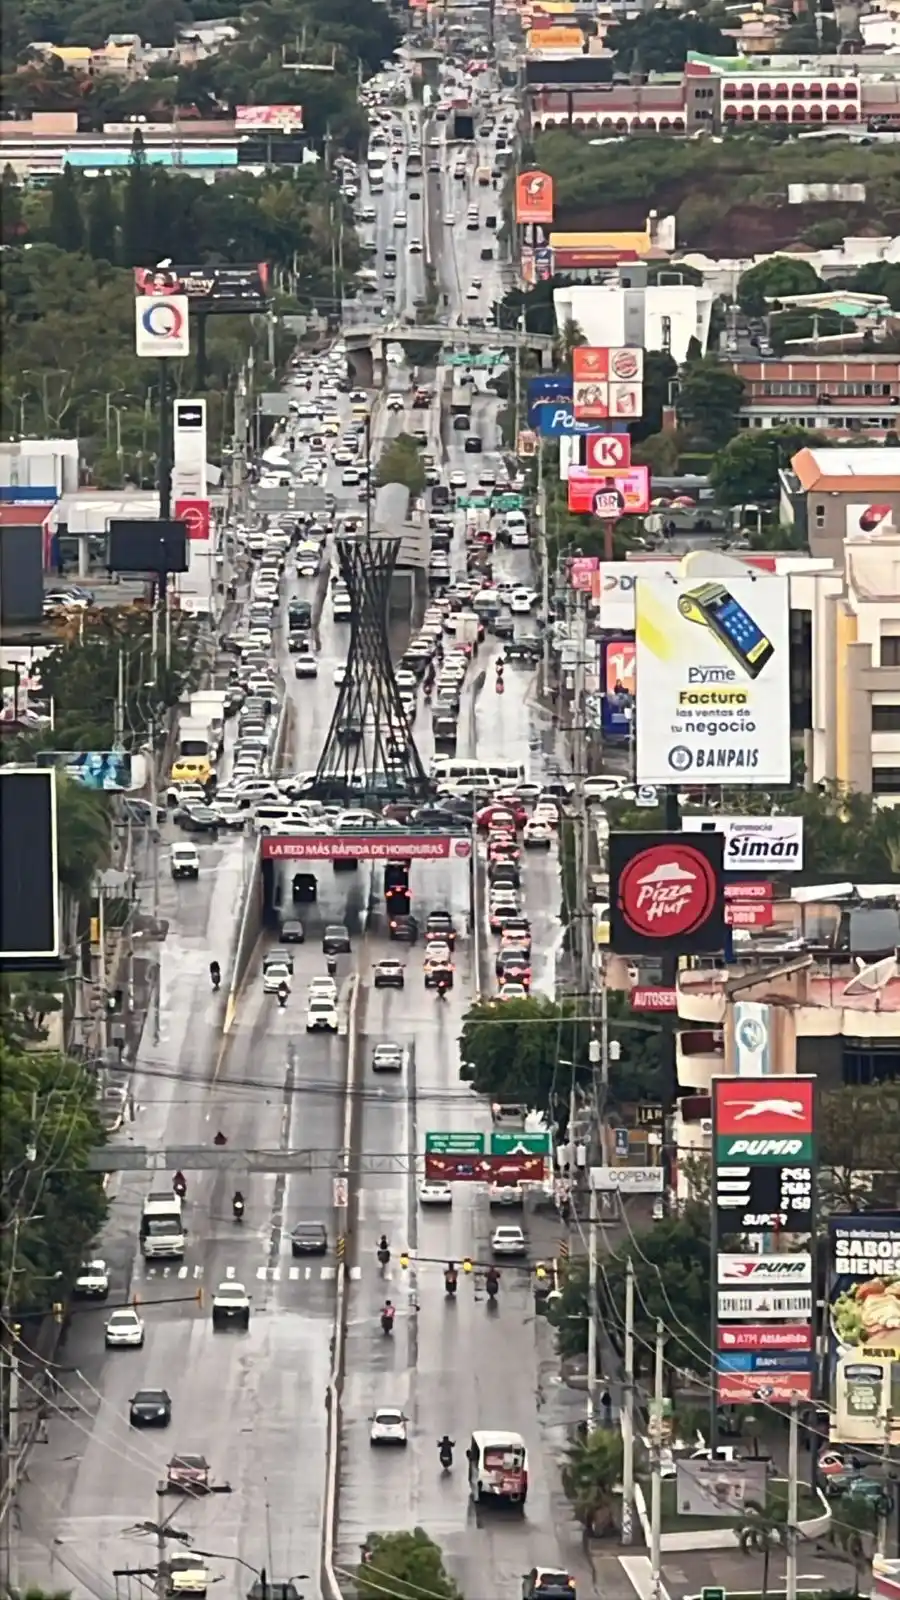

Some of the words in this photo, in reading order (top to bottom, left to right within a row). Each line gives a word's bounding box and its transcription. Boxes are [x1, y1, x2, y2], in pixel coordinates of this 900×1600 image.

[601, 443, 619, 463] K
[688, 667, 736, 683] Pyme
[679, 692, 747, 704] Factura
[676, 708, 693, 717] las
[695, 709, 734, 717] ventas
[736, 708, 751, 717] de
[685, 718, 756, 736] negocio
[696, 748, 759, 767] BANPAIS
[730, 823, 773, 831] Farmacia
[269, 845, 282, 855] LA
[283, 845, 304, 855] RED
[371, 844, 385, 855] DE
[386, 844, 444, 855] HONDURAS
[636, 880, 693, 908] Pizza
[646, 898, 691, 922] Hut
[727, 1139, 803, 1156] PUMA
[609, 1171, 660, 1183] COPEMH
[754, 1263, 806, 1273] PUMA
[737, 1333, 758, 1344] ATM
